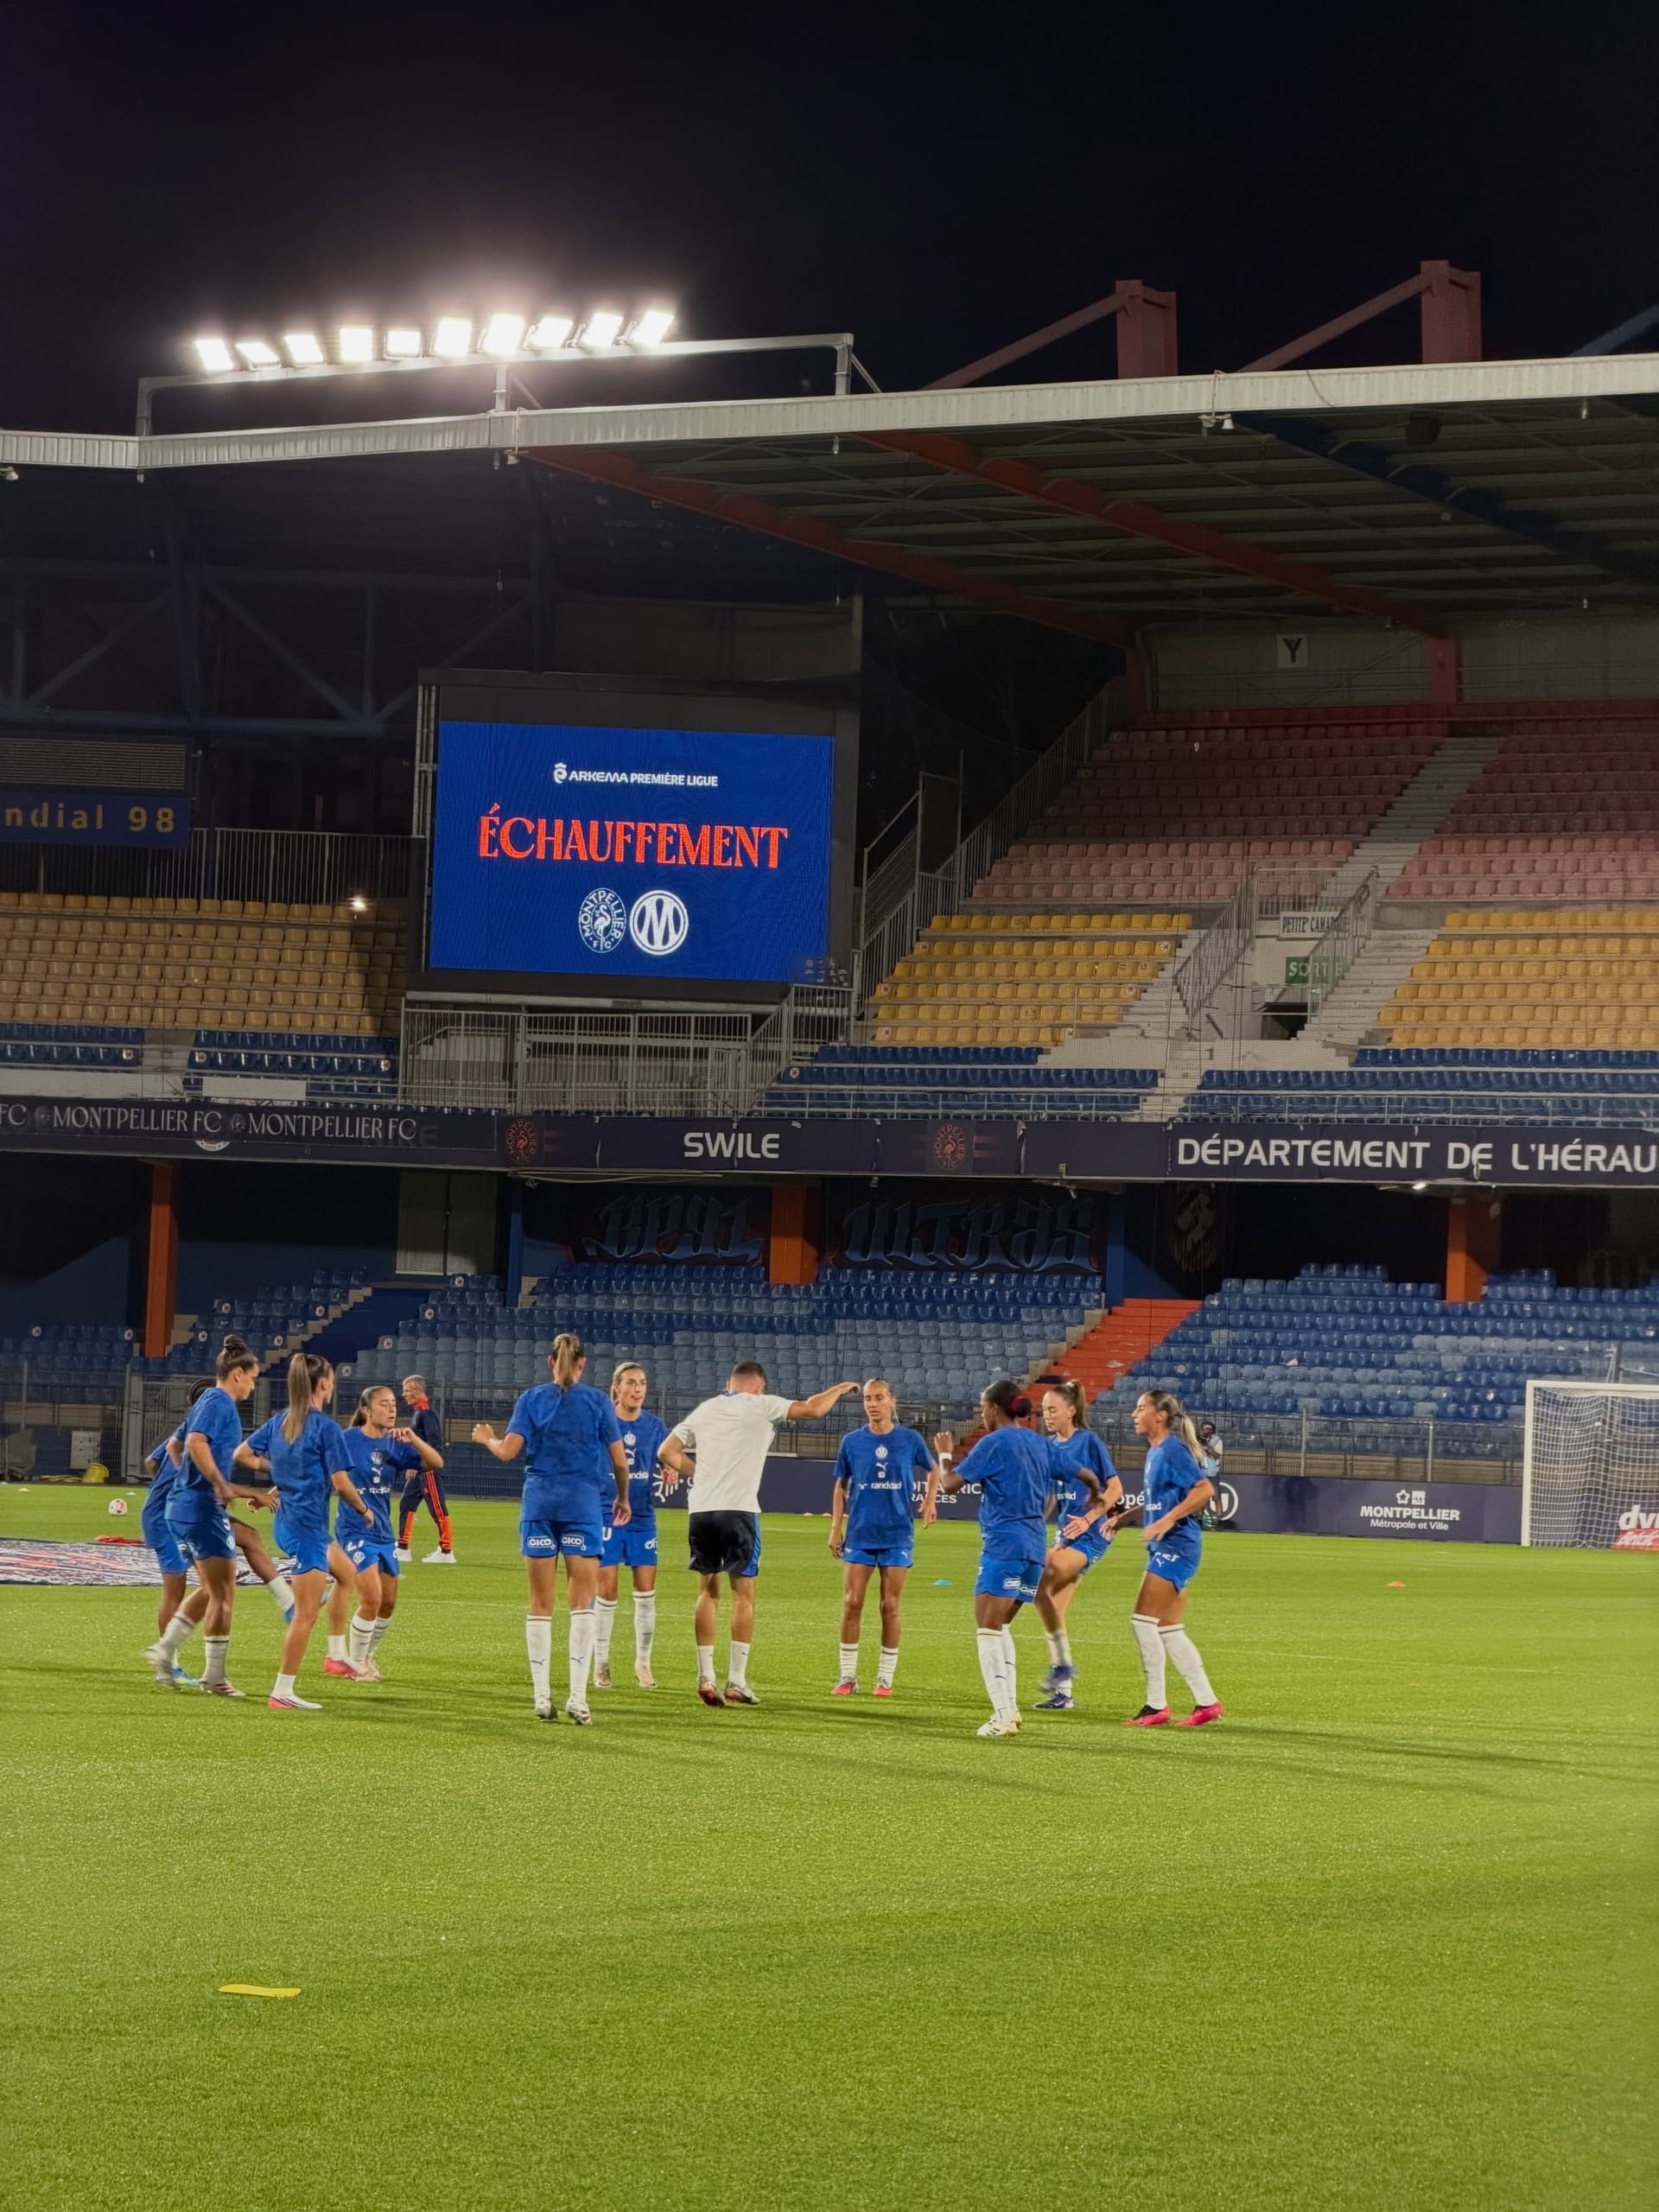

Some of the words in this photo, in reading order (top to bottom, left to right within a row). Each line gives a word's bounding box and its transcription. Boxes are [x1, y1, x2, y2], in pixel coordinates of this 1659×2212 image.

[1283, 638, 1303, 664] Y
[569, 770, 628, 784] ARKEMA
[630, 772, 685, 785] PREMIÈRE
[687, 774, 718, 787] LIGUE
[4, 802, 104, 830] ndial
[129, 805, 175, 833] 98
[479, 802, 788, 869] ÉCHAUFFEMENT
[580, 890, 625, 940] MONTPELLIER
[54, 1106, 188, 1132] MONTPELLIER
[194, 1110, 222, 1133] FC
[248, 1112, 383, 1140] MONTPELLIER
[388, 1118, 417, 1141] FC
[683, 1133, 779, 1159] SWILE
[1178, 1134, 1430, 1169] DÉPARTEMENT
[1447, 1142, 1493, 1170] DE
[1359, 1506, 1461, 1521] MONTPELLIER
[1370, 1519, 1415, 1530] Métropole
[1429, 1522, 1449, 1531] Ville
